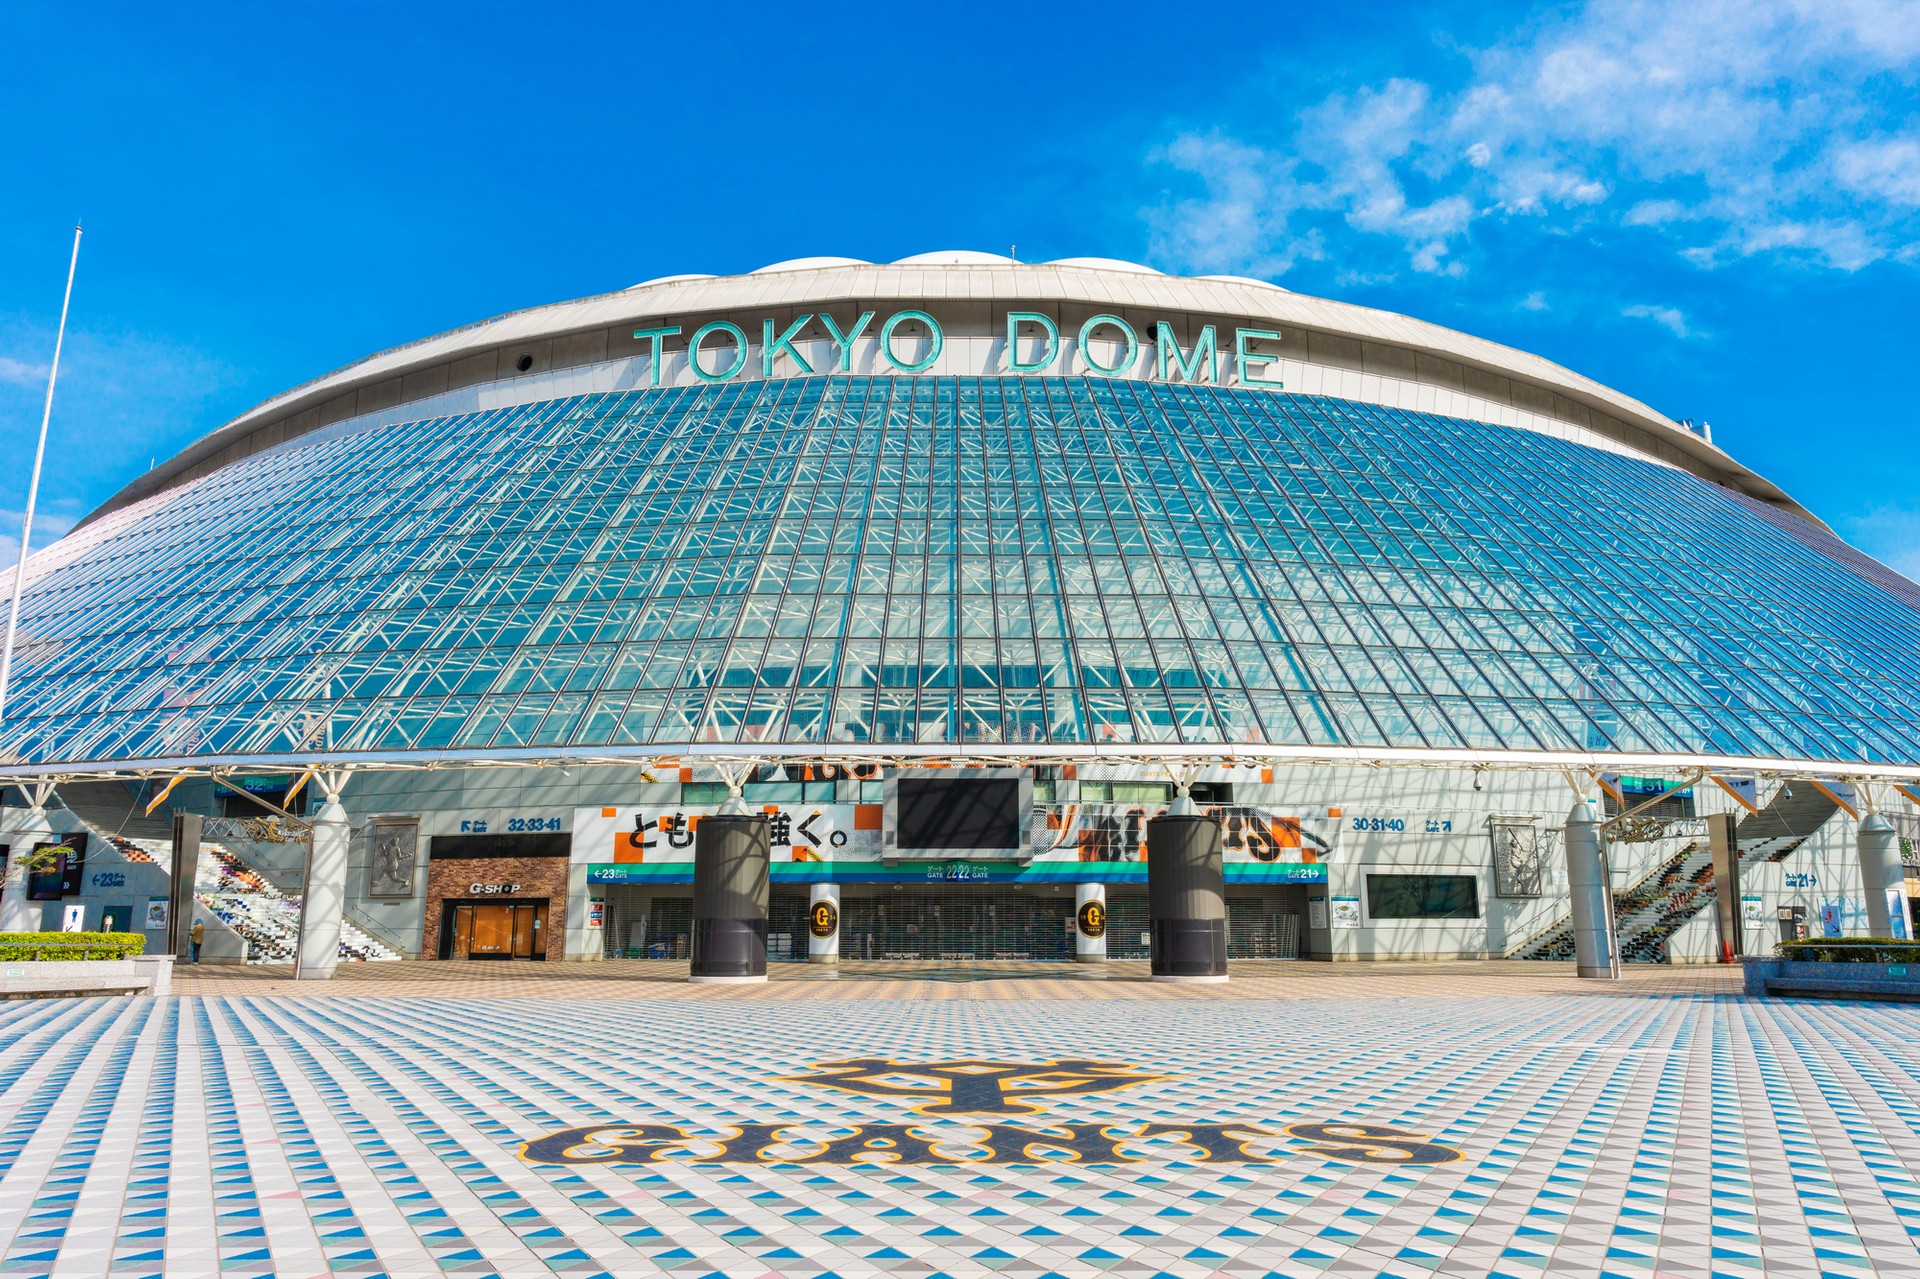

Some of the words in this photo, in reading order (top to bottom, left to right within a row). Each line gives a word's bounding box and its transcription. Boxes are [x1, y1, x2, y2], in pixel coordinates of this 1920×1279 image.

[632, 311, 944, 387] TOKYO
[1006, 311, 1284, 390] DOME
[629, 811, 848, 849] とも強く。
[602, 868, 615, 879] 23
[946, 864, 957, 879] 22
[958, 864, 970, 879] 22
[1300, 868, 1312, 878] 21
[100, 872, 113, 887] 23
[1797, 873, 1808, 887] 21
[469, 882, 521, 894] G-SHOP
[816, 907, 829, 925] G
[1087, 907, 1100, 925] G
[521, 1121, 1468, 1166] GIANTS
